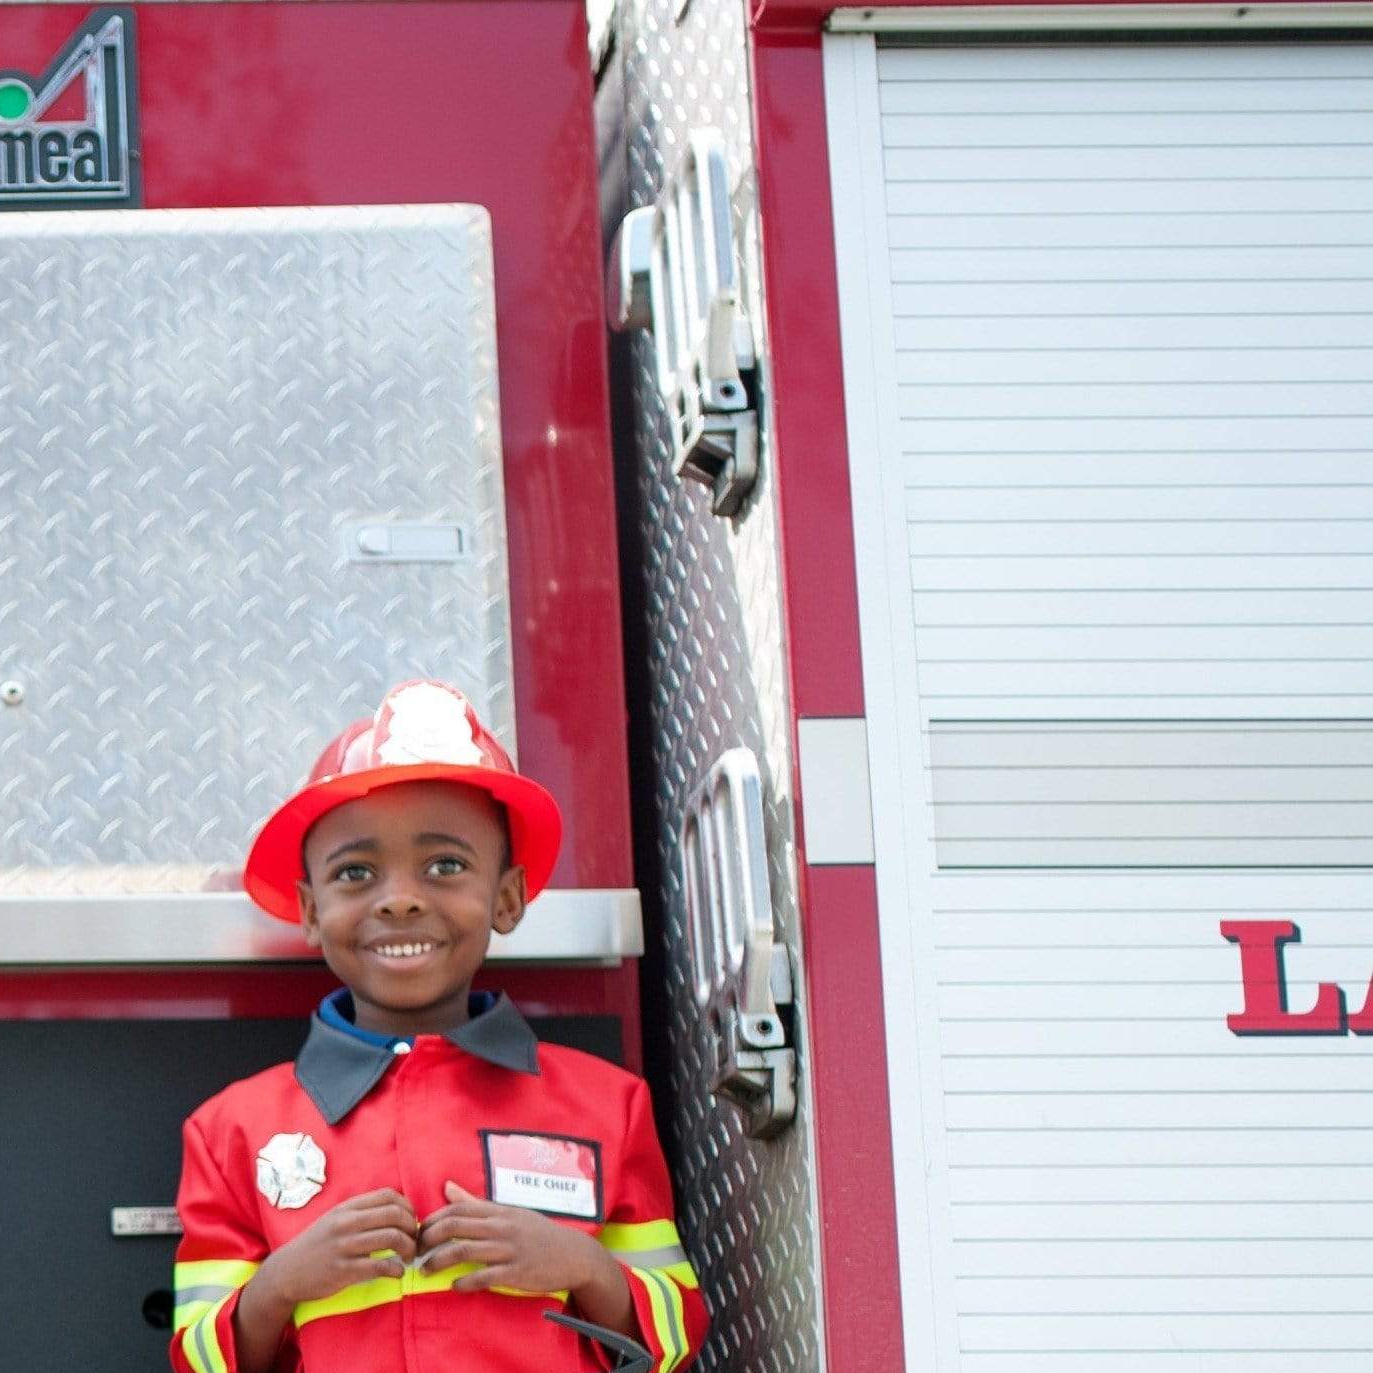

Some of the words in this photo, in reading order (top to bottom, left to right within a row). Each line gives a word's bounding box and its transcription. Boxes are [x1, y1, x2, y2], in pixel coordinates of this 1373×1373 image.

[1219, 919, 1373, 1037] L
[514, 1174, 541, 1187] FIRE
[544, 1178, 578, 1193] CHIEF
